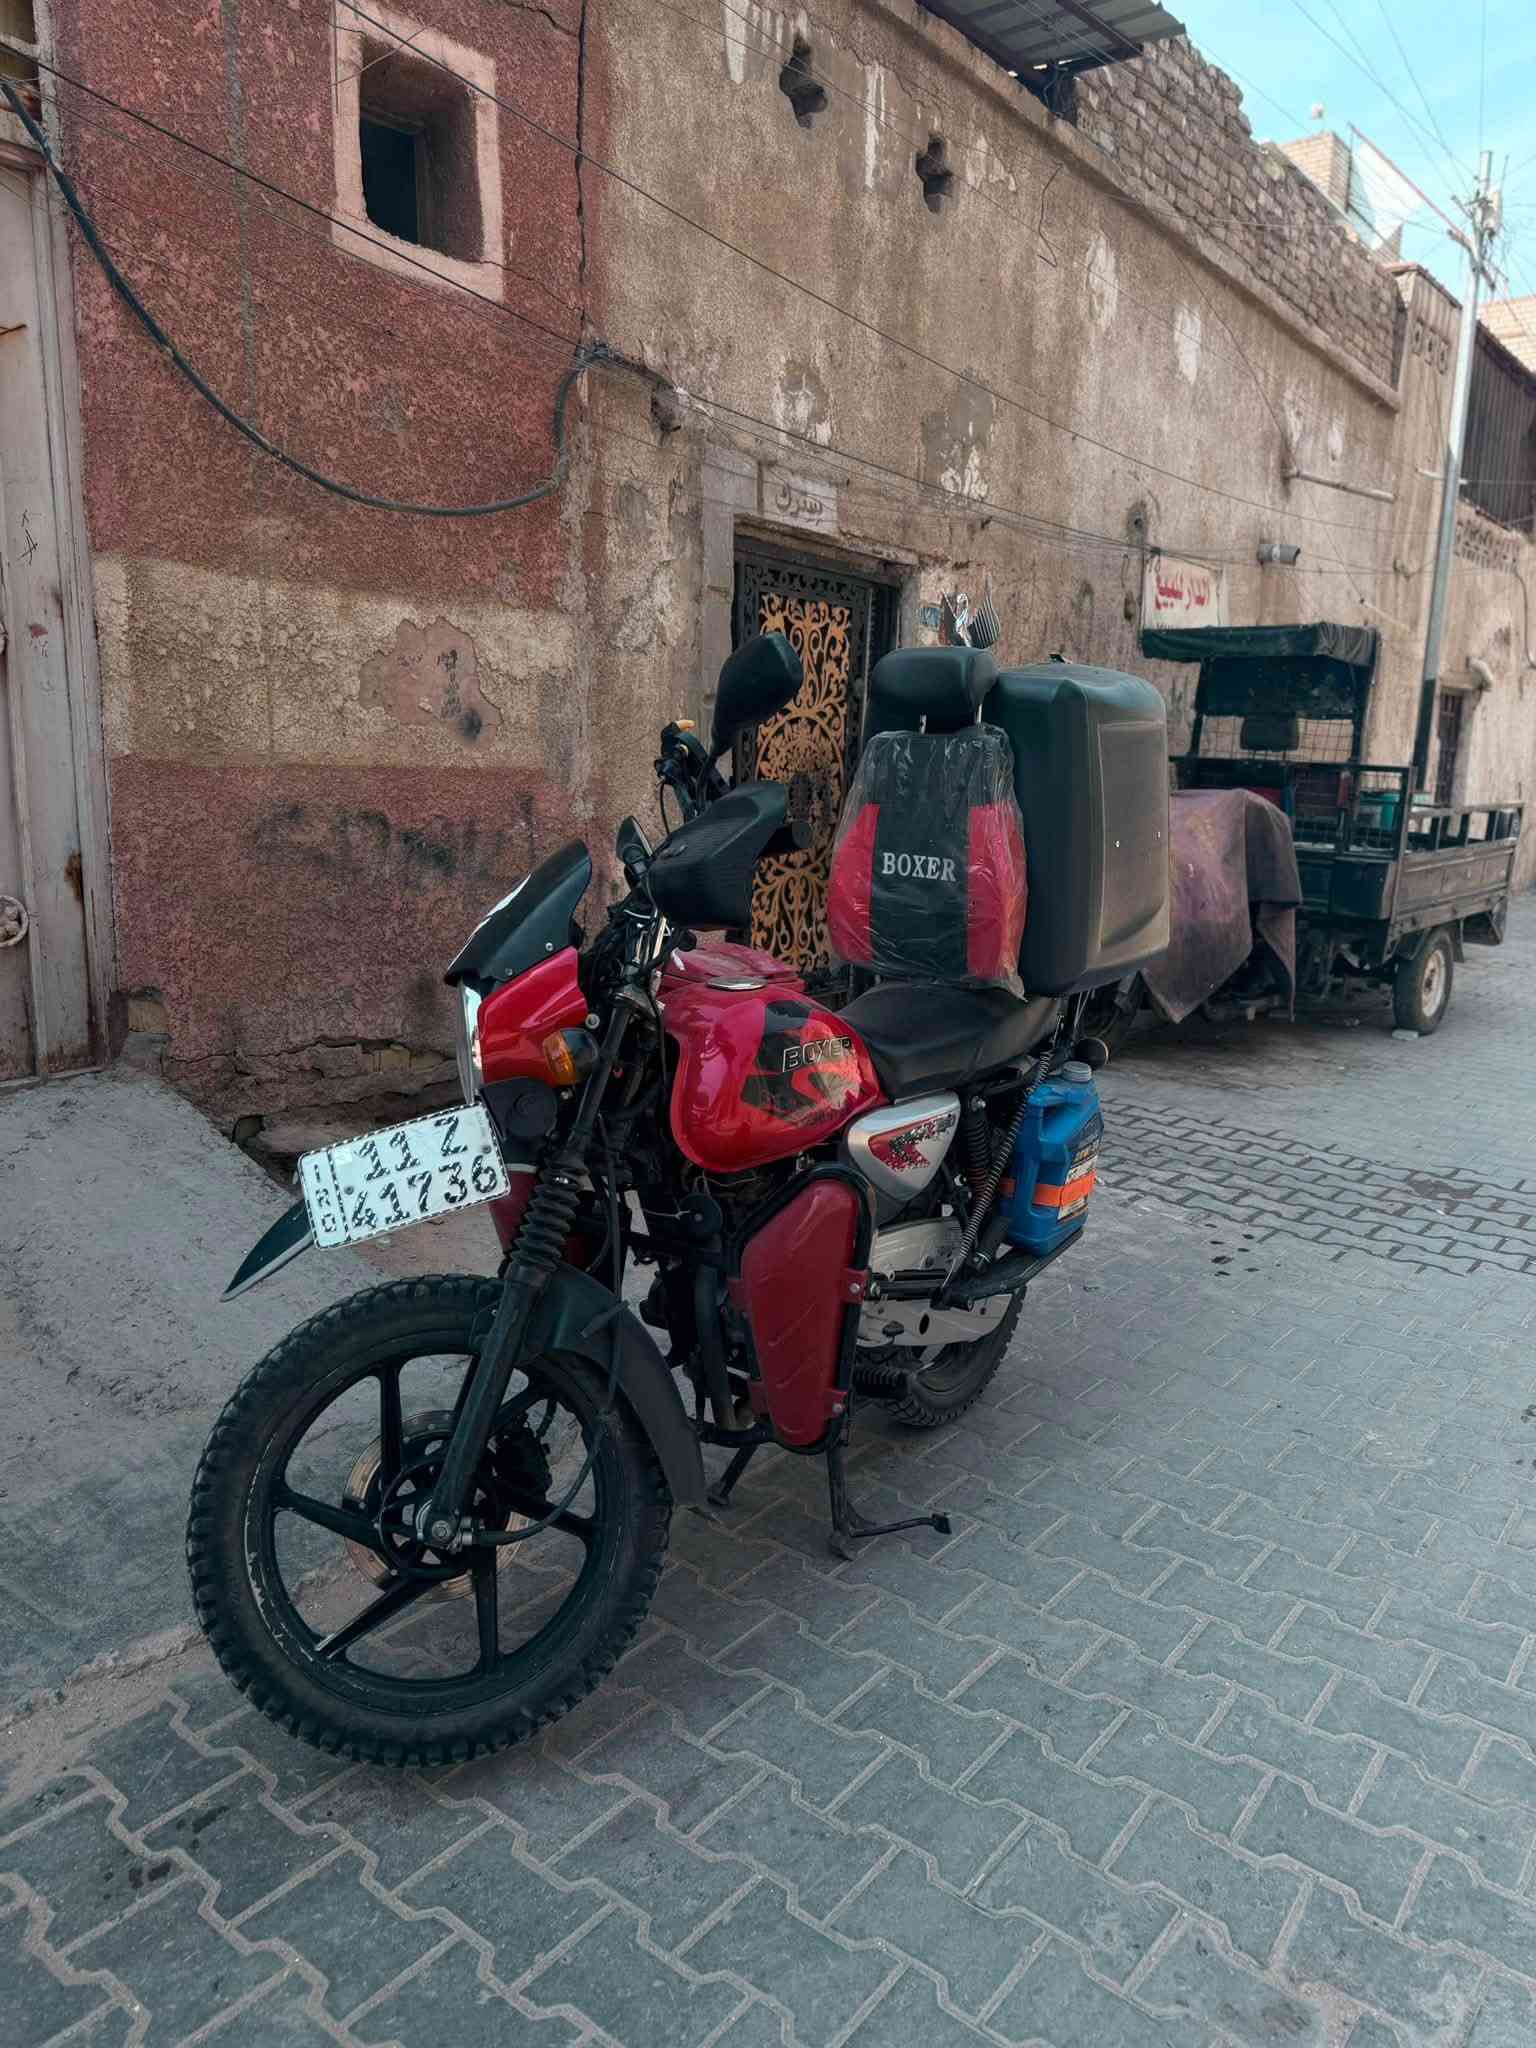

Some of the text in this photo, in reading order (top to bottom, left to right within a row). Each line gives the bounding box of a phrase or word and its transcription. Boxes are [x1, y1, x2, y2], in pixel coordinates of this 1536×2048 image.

[882, 851, 957, 882] BOXER
[782, 1035, 853, 1073] BOXER
[434, 1114, 468, 1157] Z
[352, 1155, 499, 1229] 41736
